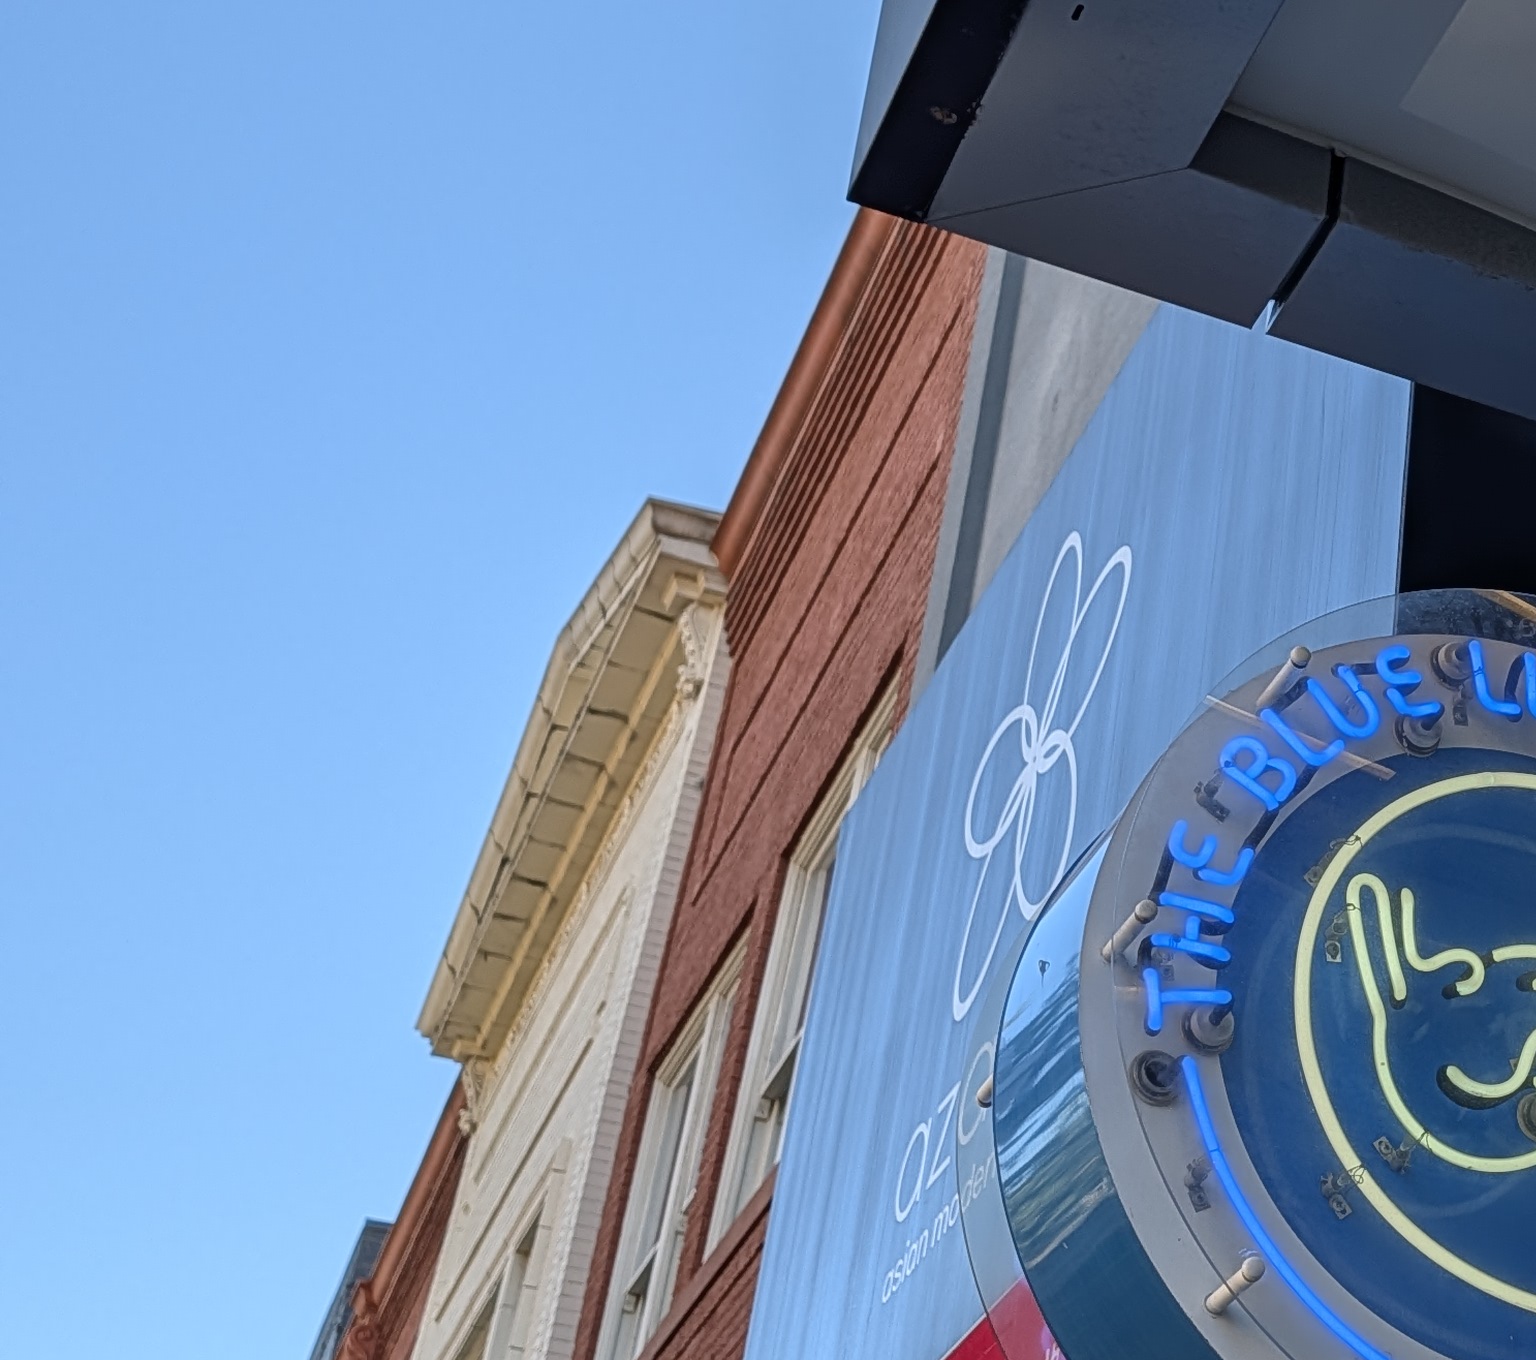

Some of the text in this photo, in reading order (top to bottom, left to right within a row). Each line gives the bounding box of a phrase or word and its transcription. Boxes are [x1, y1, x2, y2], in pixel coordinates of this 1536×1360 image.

[1143, 819, 1254, 1033] THE
[1218, 646, 1443, 811] BLUE
[895, 1041, 996, 1222] aza
[881, 1229, 928, 1304] asian
